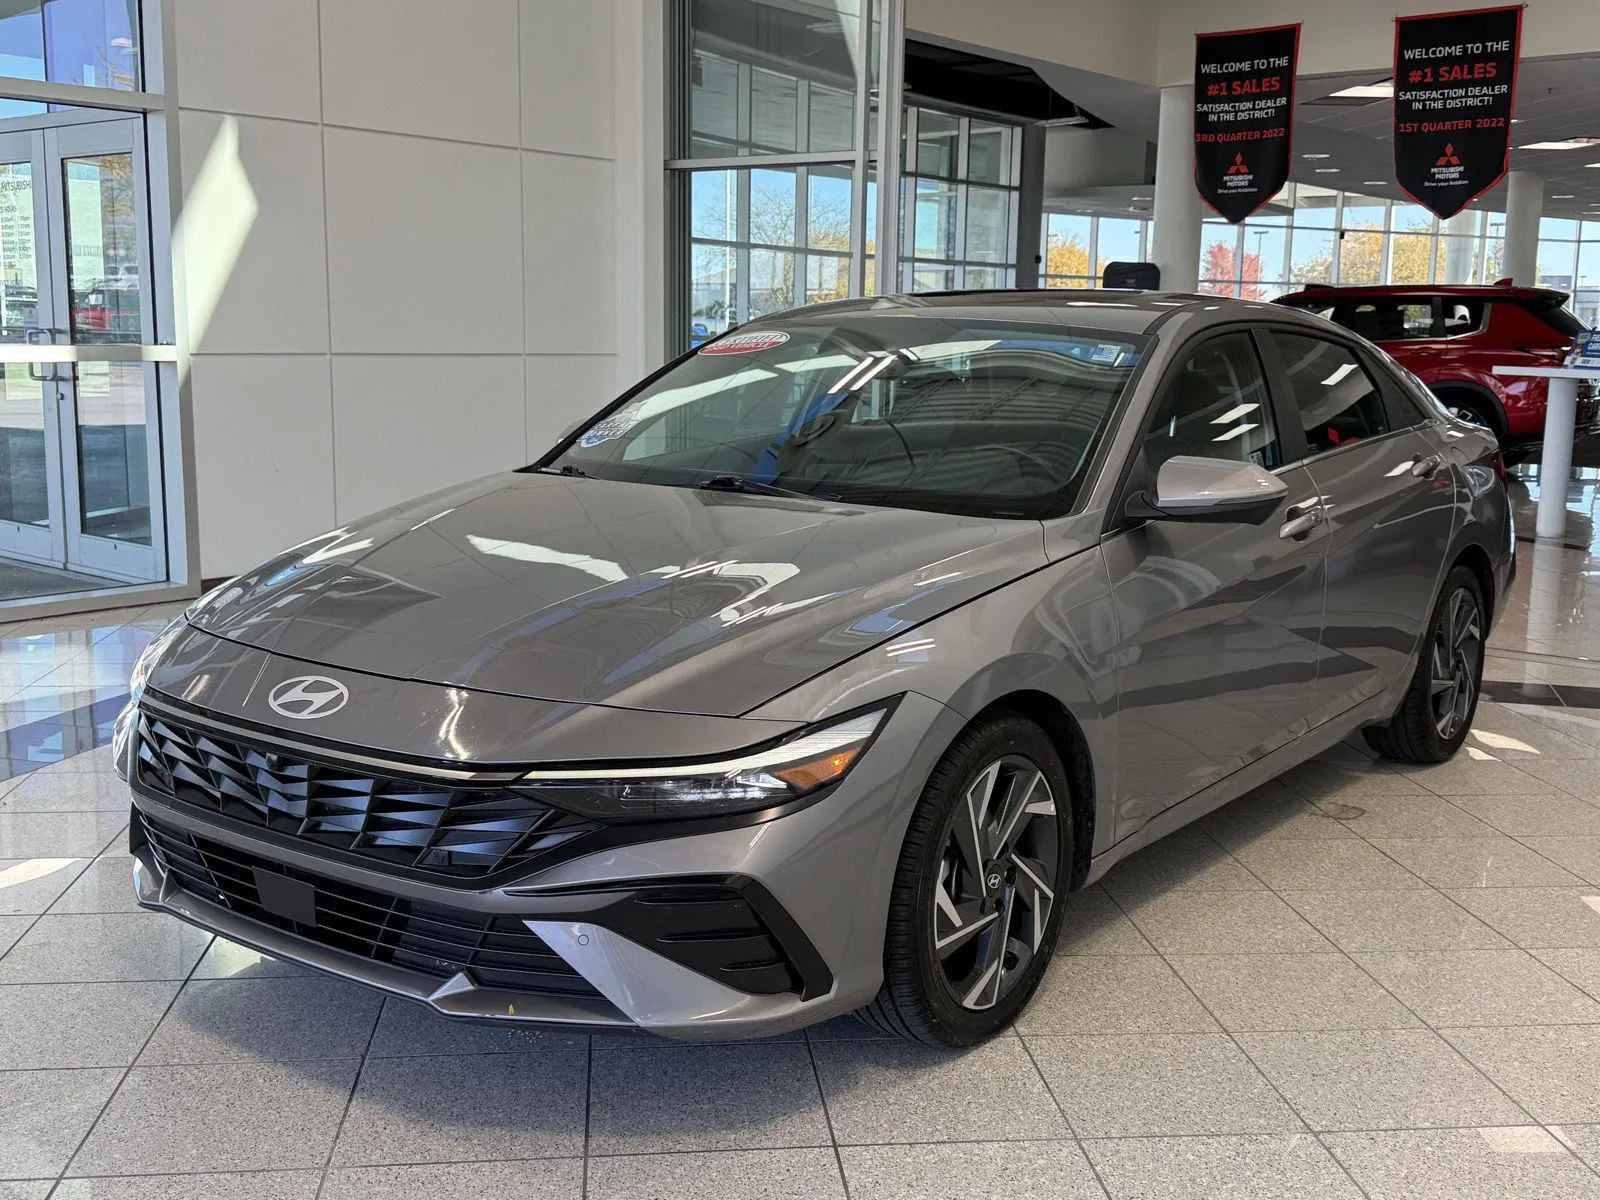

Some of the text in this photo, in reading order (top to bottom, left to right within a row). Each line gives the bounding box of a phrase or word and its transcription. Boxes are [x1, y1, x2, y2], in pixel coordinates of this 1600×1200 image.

[1404, 40, 1510, 60] WELCOME TO THE
[1200, 56, 1289, 73] WELCOME TO THE
[1409, 62, 1497, 84] #1 SALES
[1207, 76, 1280, 96] #1 SALES
[1399, 85, 1508, 101] SATISFACTION DEALER
[1196, 97, 1287, 112] SATISFACTION DEALER
[1412, 97, 1493, 110] IN THE DISTRICT!
[1208, 109, 1275, 122] IN THE DISTRICT!
[1399, 117, 1505, 134] 1ST QUARTER 2022
[1195, 128, 1285, 143] 3RD QUARTER 2022
